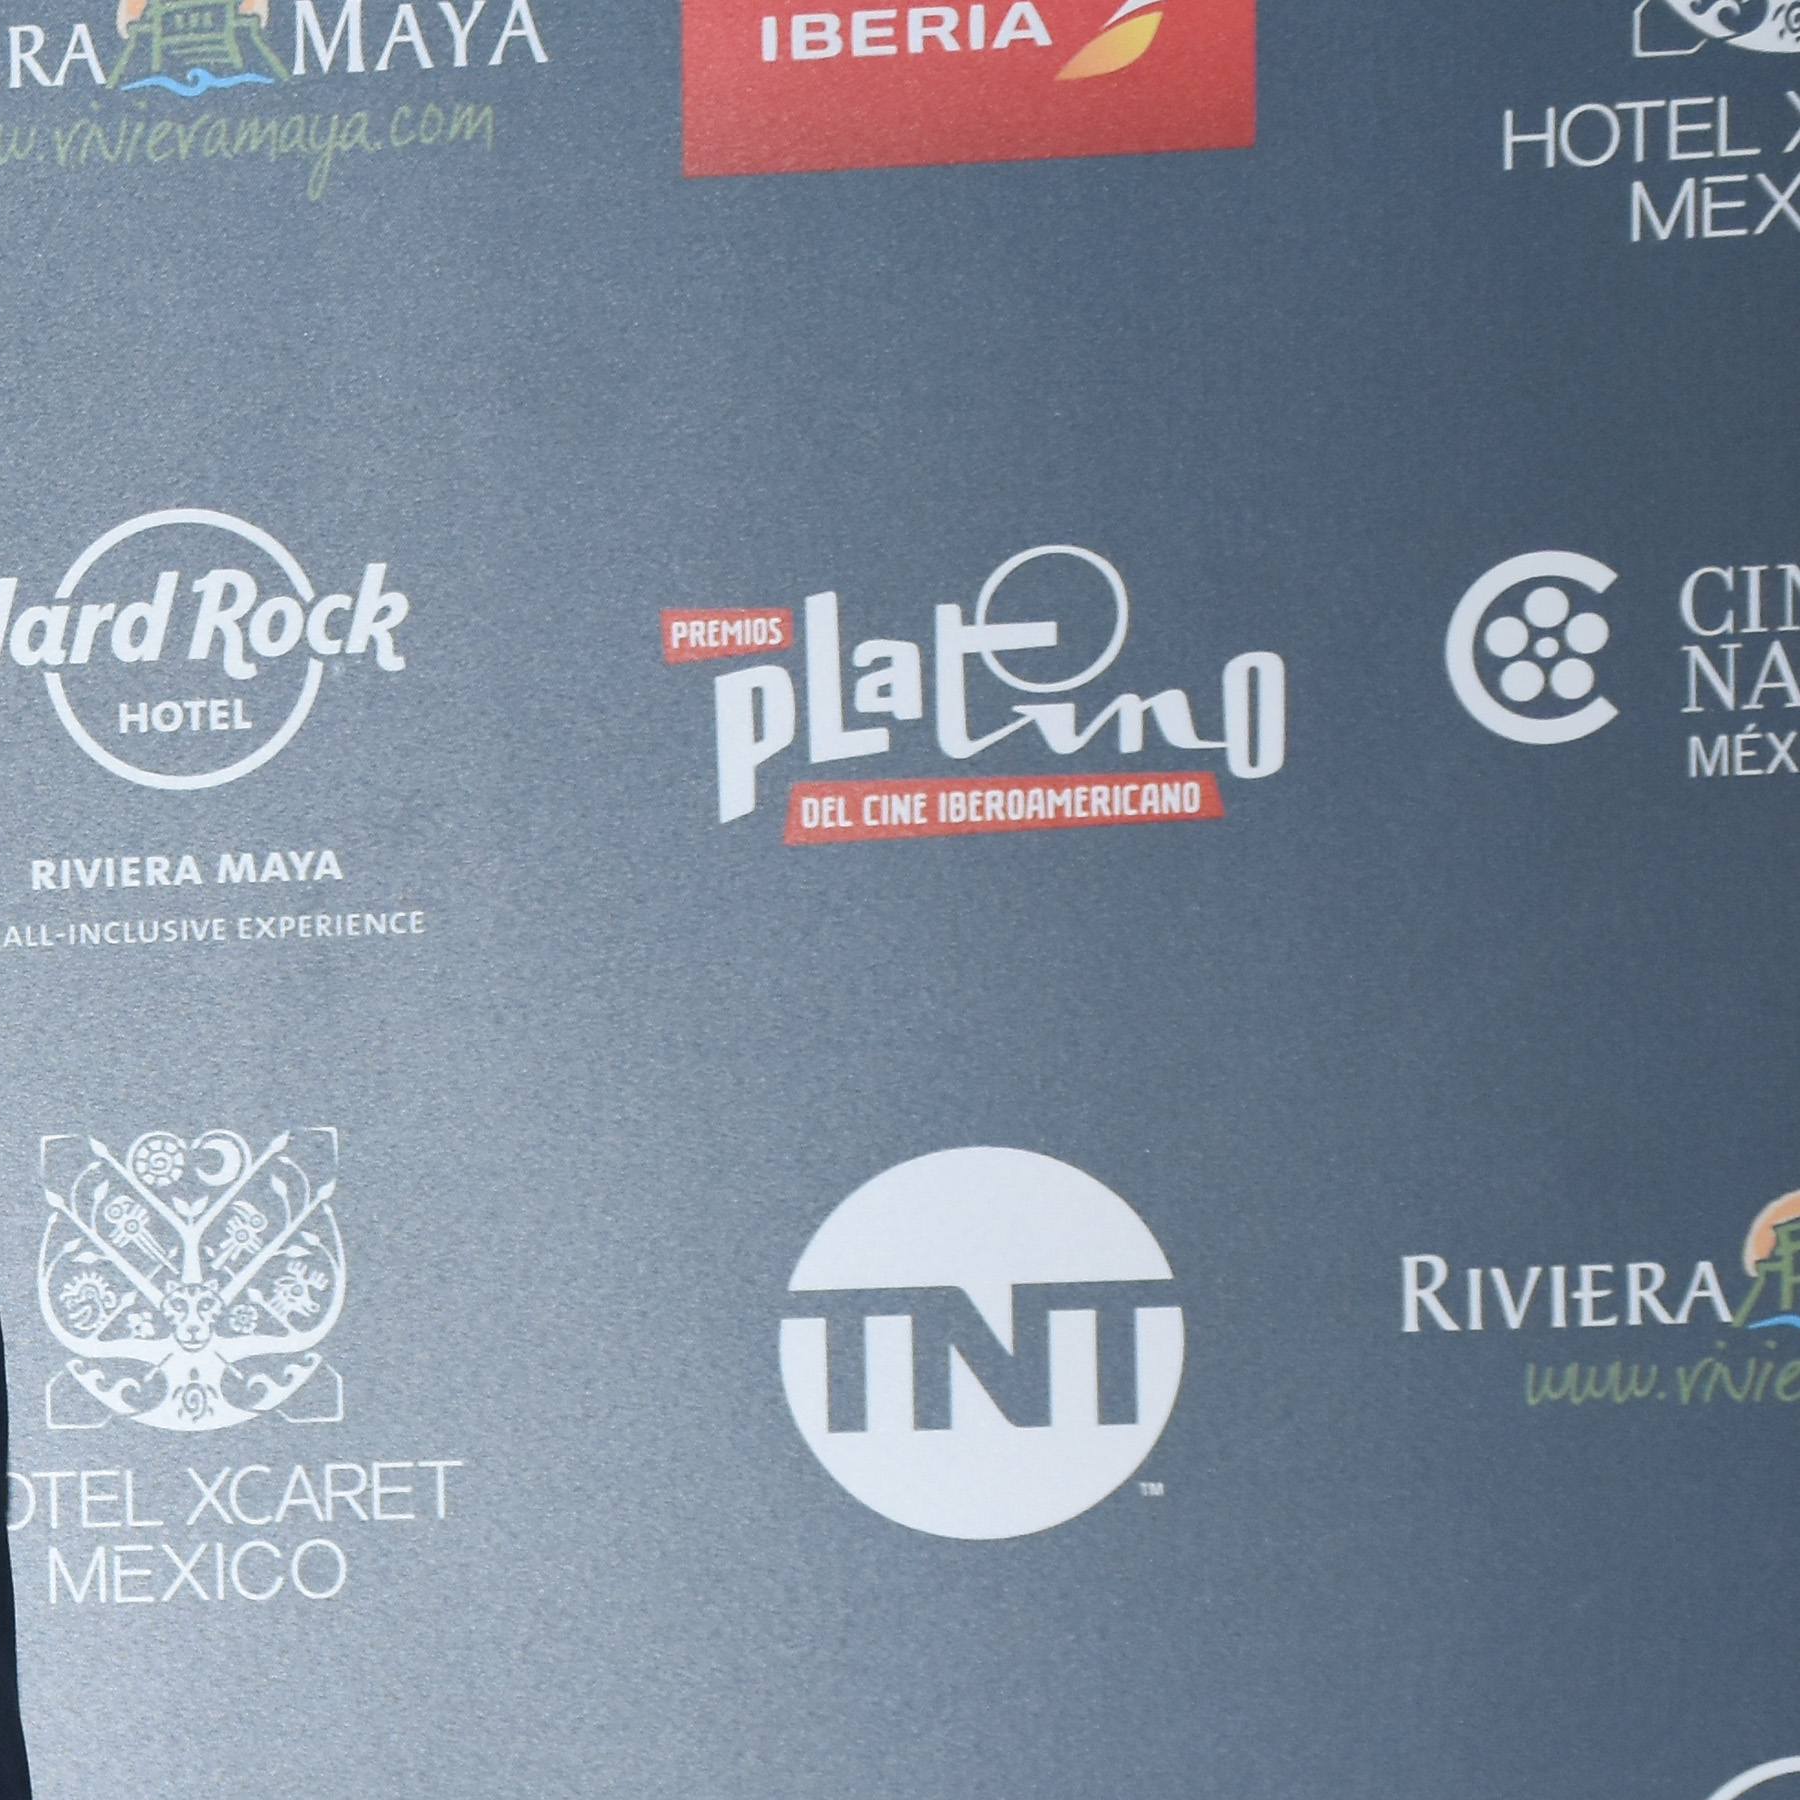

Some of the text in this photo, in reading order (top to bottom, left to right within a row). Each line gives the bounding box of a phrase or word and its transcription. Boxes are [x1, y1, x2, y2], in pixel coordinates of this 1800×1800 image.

[762, 1, 1051, 61] IBERIA
[1504, 96, 1760, 170] HOTEL
[1632, 173, 1800, 241] MEX
[188, 563, 409, 679] Rock
[671, 617, 782, 648] PREMIOS
[120, 699, 252, 733] HOTEL
[1689, 723, 1798, 777] MÉX
[802, 782, 1200, 828] DEL CINE IBEROAMERICANO
[32, 850, 343, 890] RIVIERA MAYA
[2, 918, 226, 947] ALL-INCLUSIVE
[238, 911, 424, 939] EXPERIENCE
[1402, 1254, 1734, 1332] RIVIERA
[781, 1278, 1184, 1434] TNT
[7, 1460, 463, 1531] OTEL XCARET
[47, 1539, 347, 1604] MEXICO
